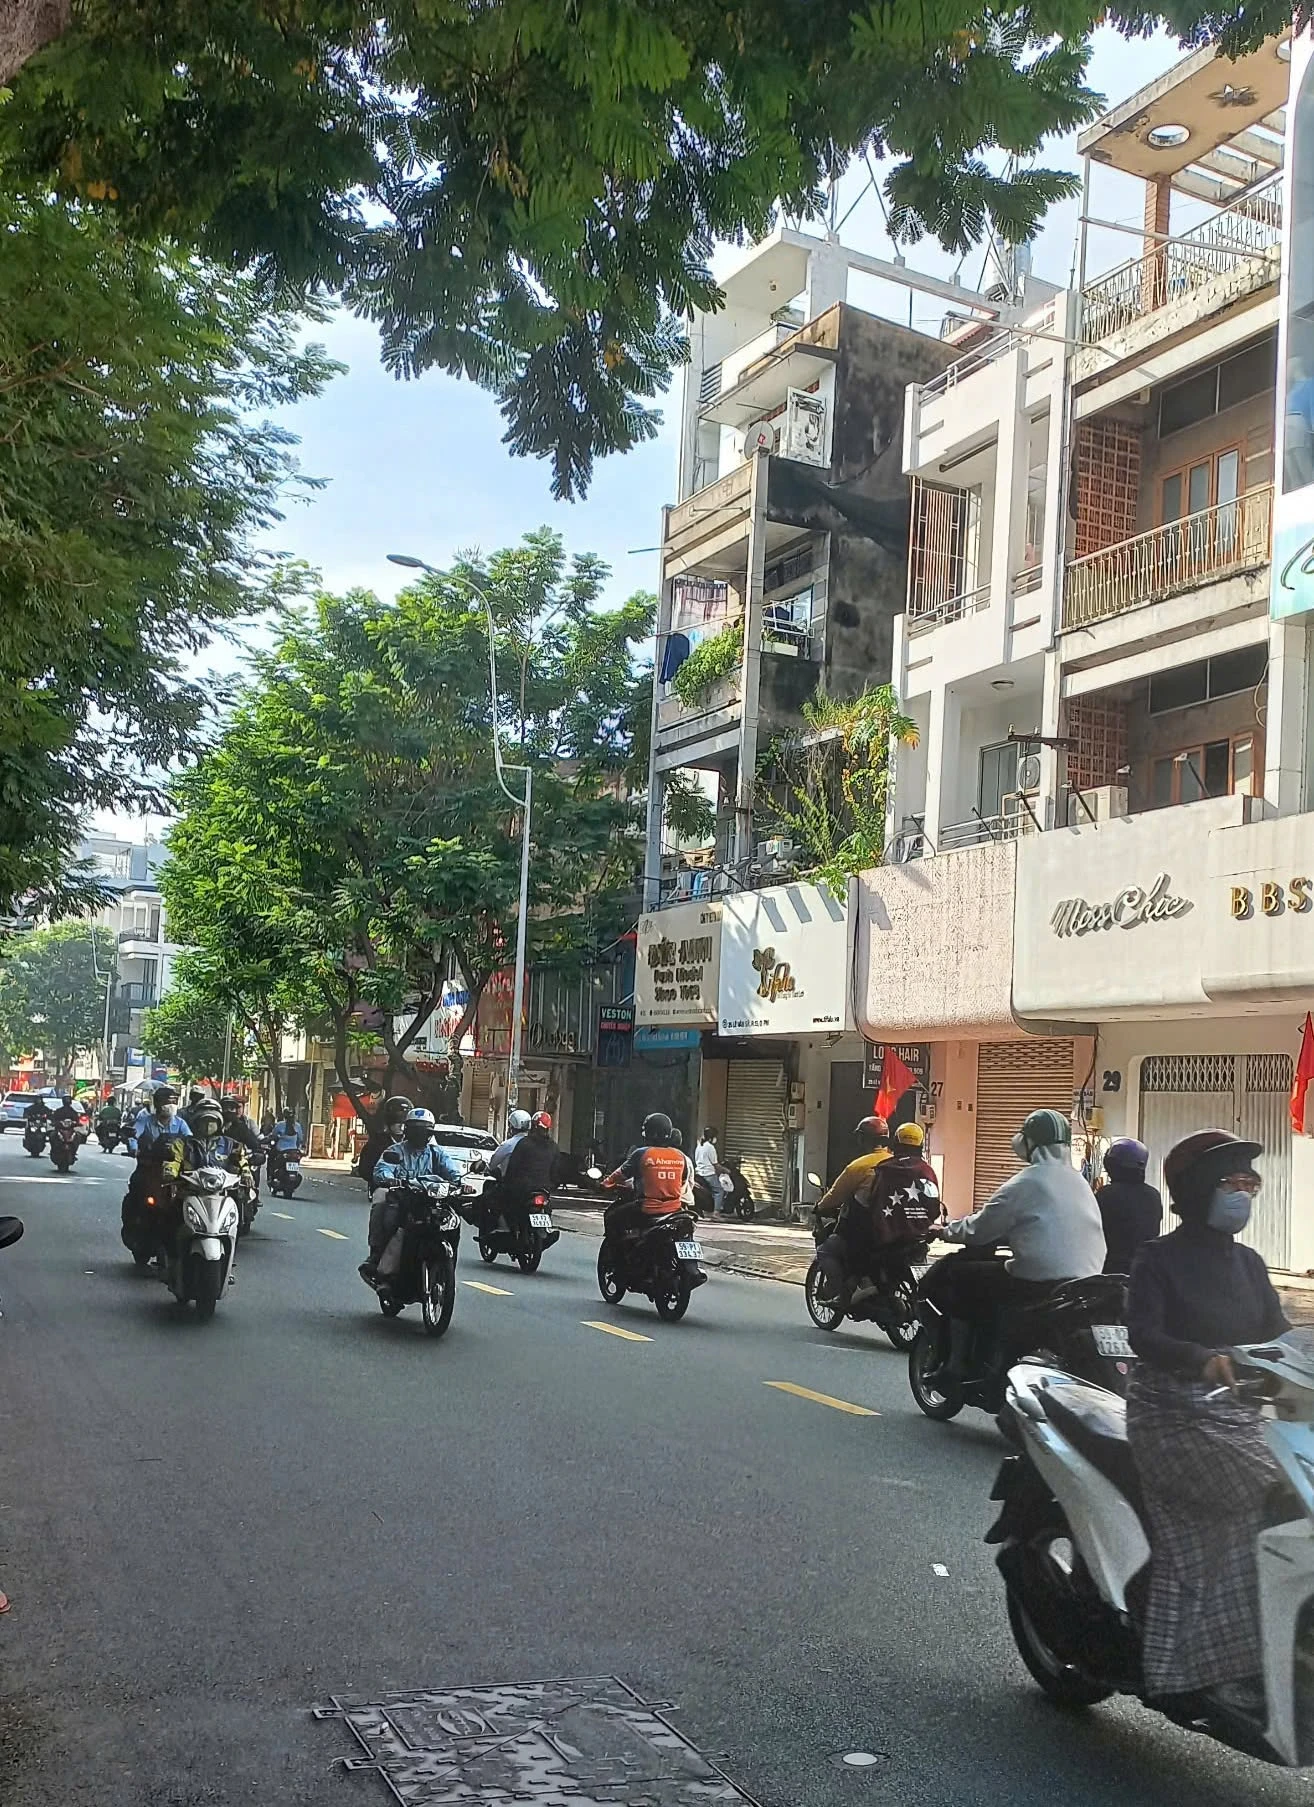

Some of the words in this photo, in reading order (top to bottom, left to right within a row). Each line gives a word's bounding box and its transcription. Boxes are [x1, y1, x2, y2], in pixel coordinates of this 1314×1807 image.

[601, 1007, 632, 1020] VESTON
[873, 1045, 897, 1060] LOG
[898, 1047, 920, 1062] HAIR
[930, 1081, 944, 1097] 27
